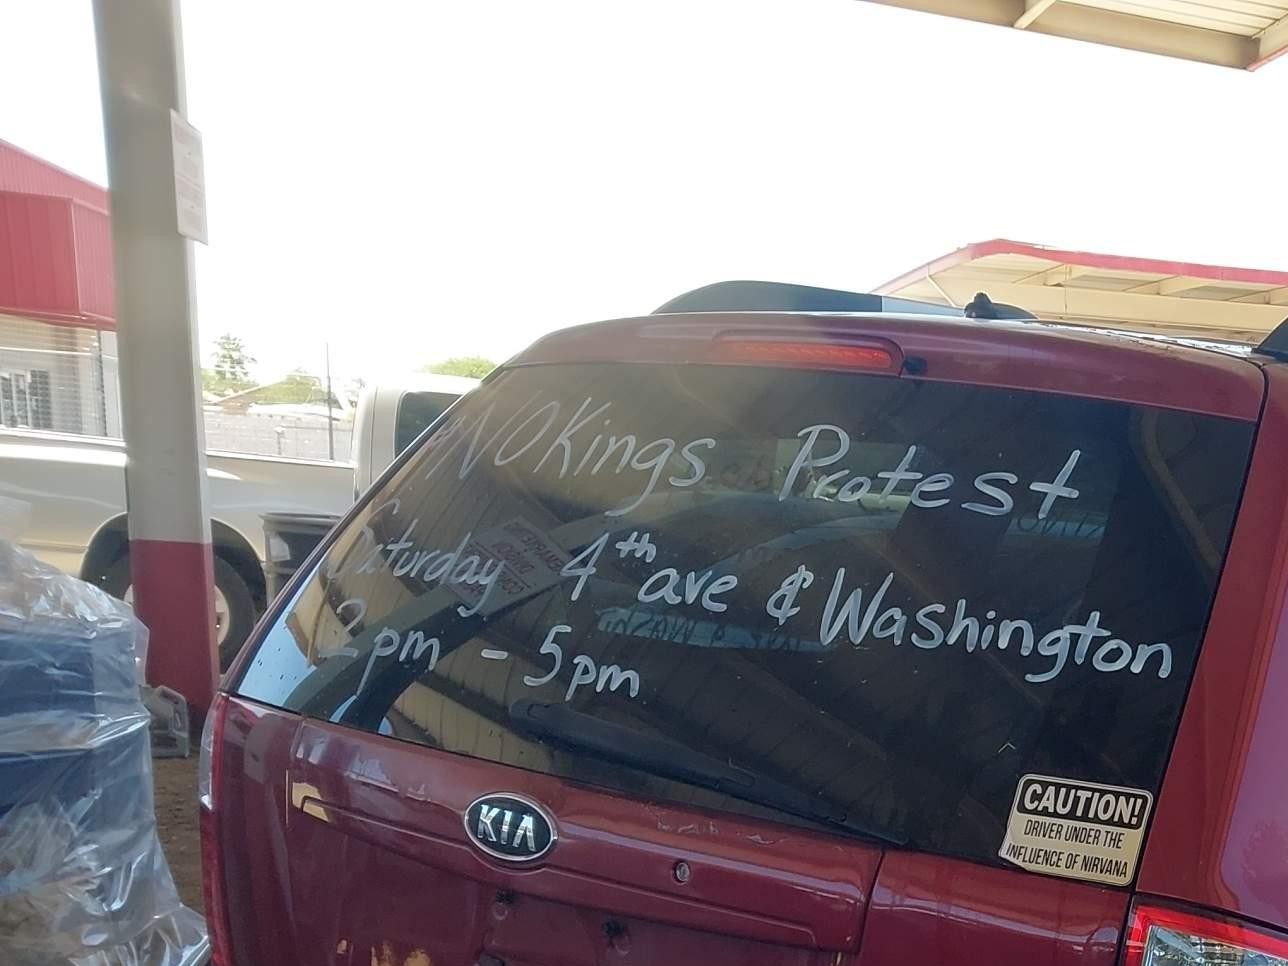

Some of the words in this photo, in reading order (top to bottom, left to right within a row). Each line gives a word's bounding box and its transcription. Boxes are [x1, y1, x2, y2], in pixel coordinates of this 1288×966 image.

[778, 423, 1081, 519] Protest
[637, 565, 739, 613] ave
[818, 566, 1173, 684] Washington
[1023, 783, 1144, 826] CAUTION!
[477, 804, 537, 853] KIA
[1023, 819, 1064, 841] DRIVER
[1064, 826, 1101, 846] UNDER
[1102, 830, 1126, 850] THE
[1005, 843, 1066, 869] INFLUENCE
[1064, 853, 1080, 871] OF
[1080, 855, 1130, 879] NIRVANA
